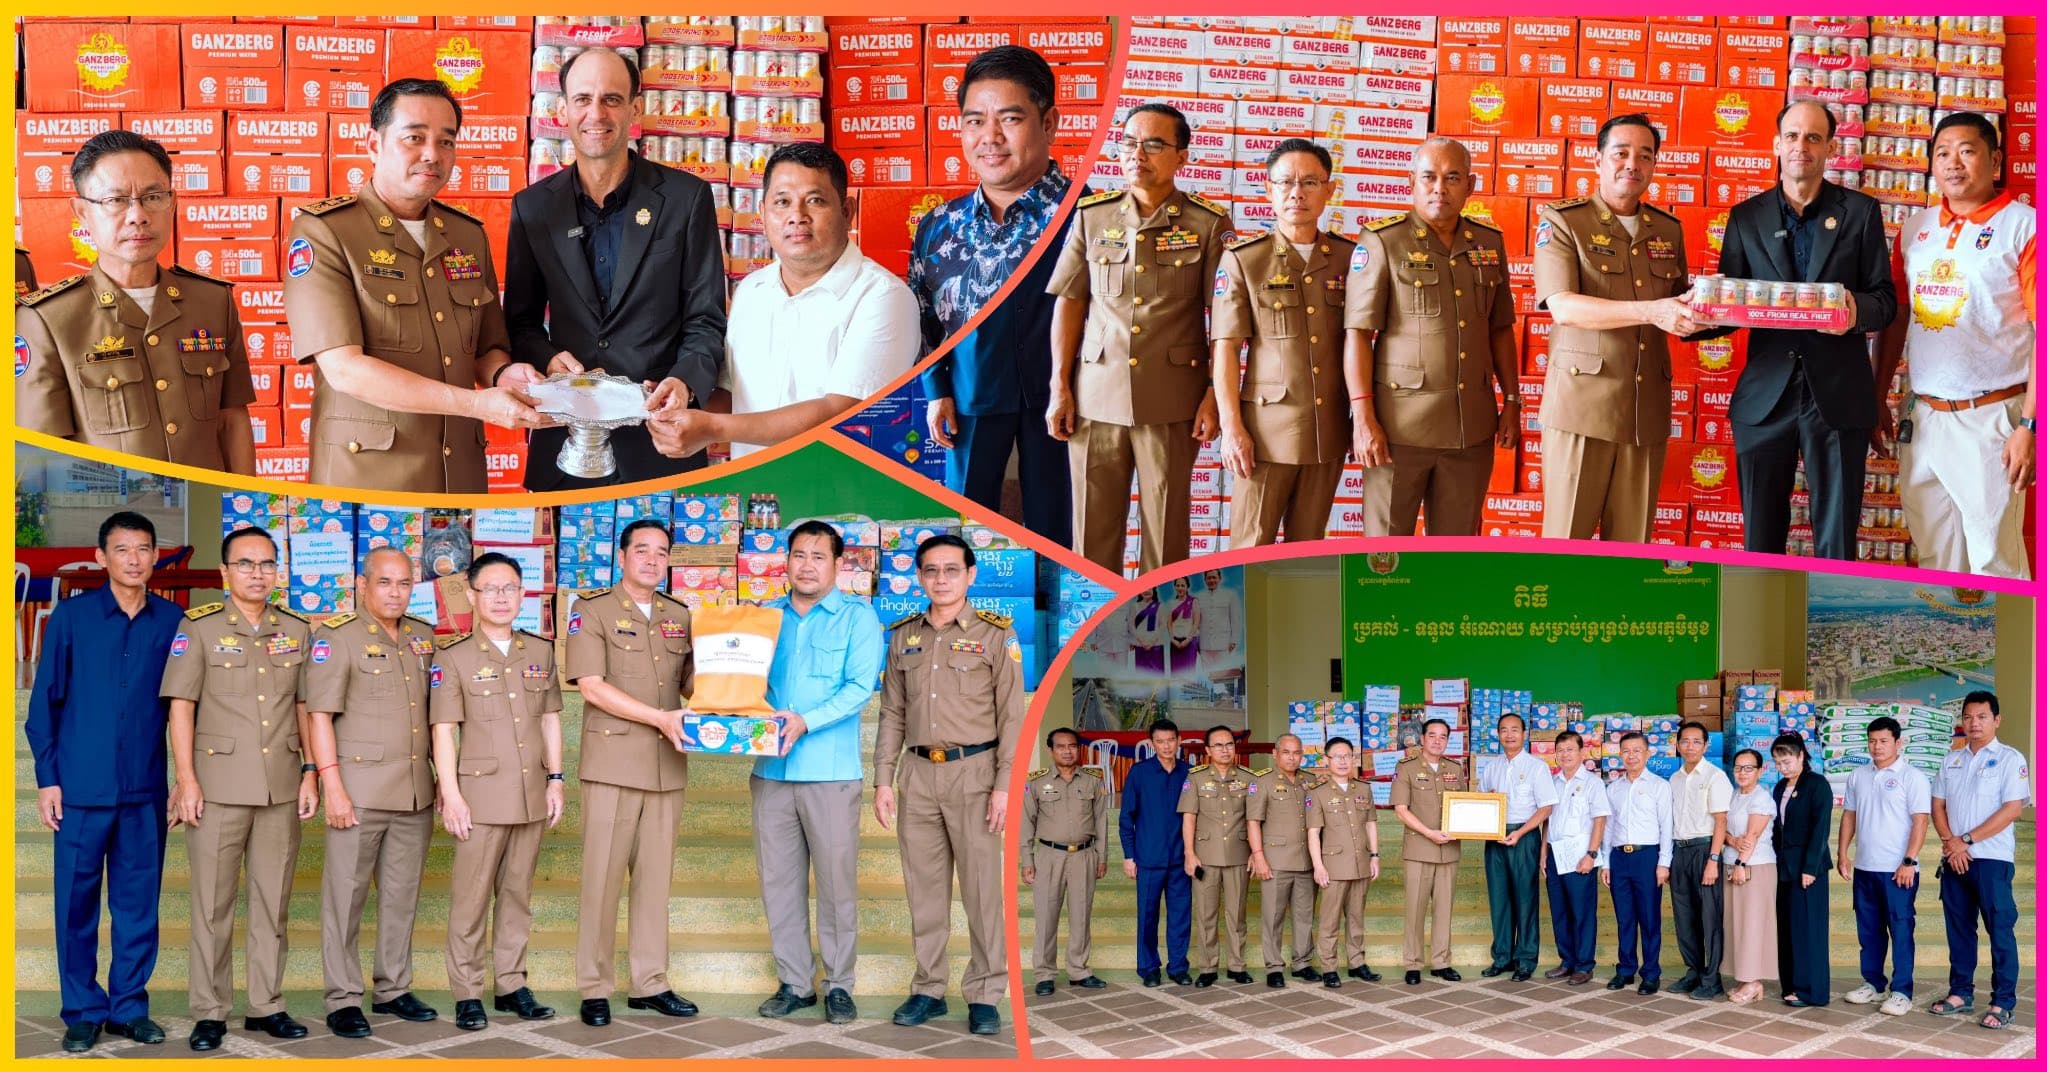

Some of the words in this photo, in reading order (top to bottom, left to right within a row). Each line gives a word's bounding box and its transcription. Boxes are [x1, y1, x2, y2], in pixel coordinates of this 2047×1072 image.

[1367, 16, 1421, 31] GANZBERG
[1444, 21, 1500, 33] GANZBERG
[1515, 24, 1570, 37] GANZBERG
[936, 33, 1010, 49] GANZBERG
[1029, 31, 1103, 48] GANZBERG
[1586, 27, 1641, 41] GANZBERG
[1656, 31, 1712, 46] GANZBERG
[1727, 34, 1783, 48] GANZBERG
[192, 34, 273, 50] GANZBERG
[296, 35, 375, 54] GANZBERG
[840, 33, 913, 51] GANZBERG
[1131, 35, 1187, 49] GANZBERG
[1214, 35, 1271, 48] GANZBERG
[1294, 41, 1349, 53] GANZBERG
[79, 54, 127, 64] GANZBERG
[437, 59, 481, 68] GANZBERG
[1126, 69, 1183, 82] GANZBERG
[1209, 68, 1266, 81] GANZBERG
[1289, 74, 1345, 87] GANZBERG
[1367, 78, 1421, 92] GANZBERG
[1547, 84, 1603, 98] GANZBERG
[1618, 88, 1674, 103] GANZBERG
[1167, 100, 1224, 113] GANZBERG
[1248, 105, 1304, 118] GANZBERG
[1716, 107, 1748, 116] GANZBERG
[26, 119, 110, 135] GANZBERG
[132, 119, 213, 135] GANZBERG
[238, 118, 318, 139] GANZBERG
[841, 115, 915, 132] GANZBERG
[1358, 115, 1413, 129] GANZBERG
[1357, 148, 1411, 161] GANZBERG
[1503, 143, 1558, 155] GANZBERG
[1715, 156, 1771, 170] GANZBERG
[1357, 183, 1411, 195] GANZBERG
[187, 205, 267, 222] GANZBERG
[1916, 285, 1964, 297] GANZBERG
[1487, 498, 1542, 512] GANZBERG
[1696, 511, 1744, 525] GANZBER
[1514, 585, 1549, 608] ពិធី
[880, 597, 921, 615] Angkor
